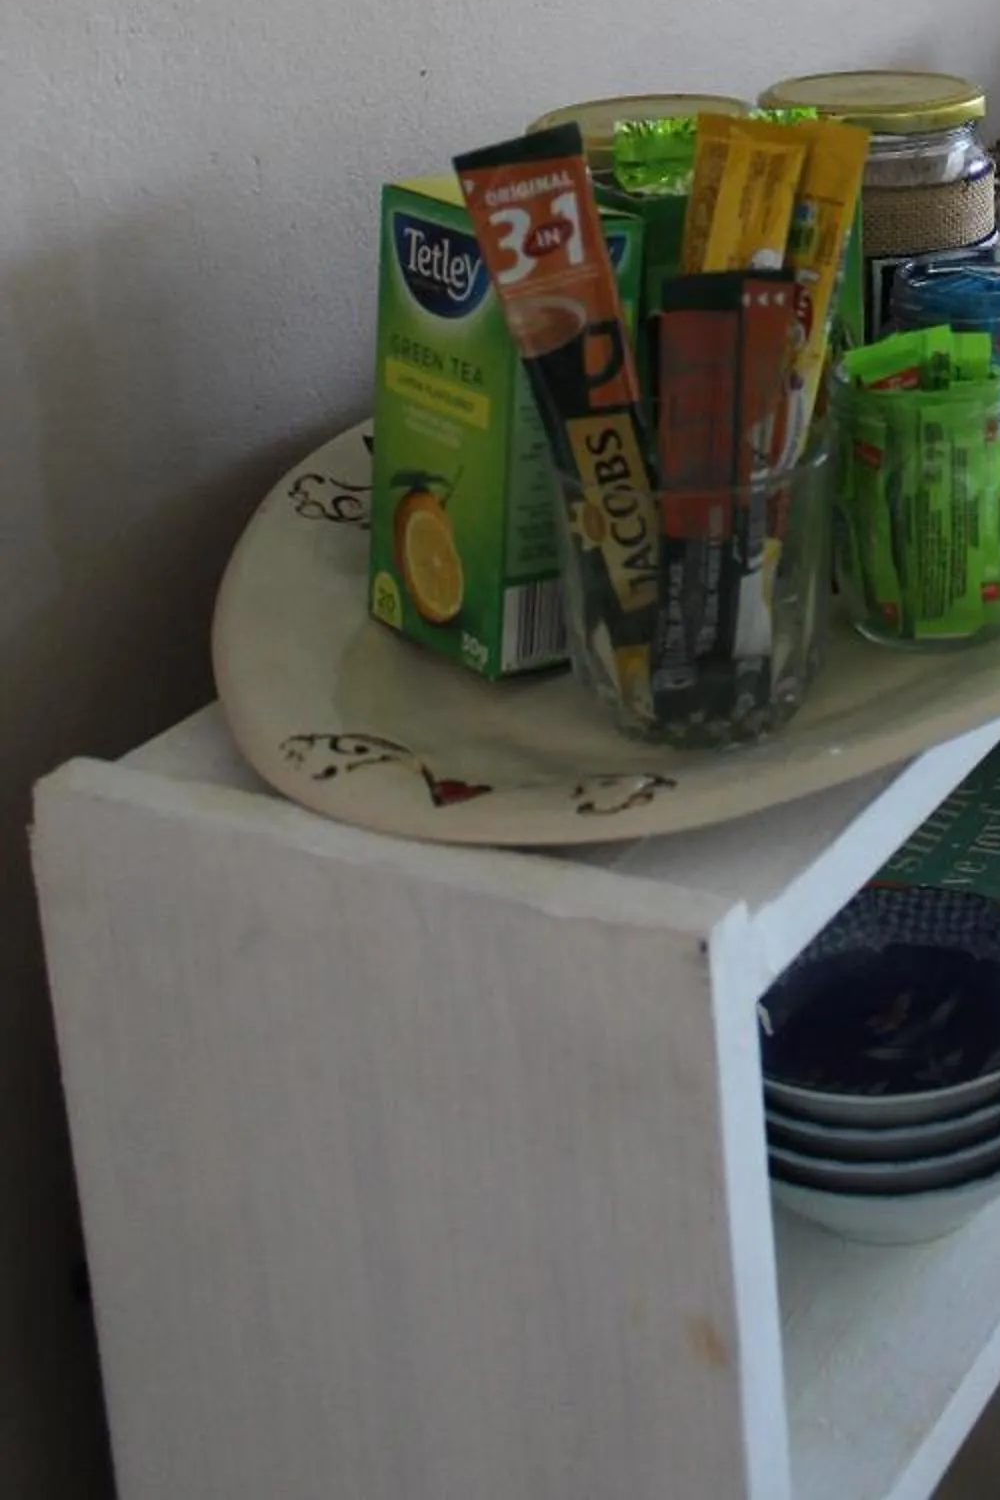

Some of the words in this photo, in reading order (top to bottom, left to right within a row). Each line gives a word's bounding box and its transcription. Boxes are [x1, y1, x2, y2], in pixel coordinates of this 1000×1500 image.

[485, 170, 575, 206] ORIGINAL
[403, 227, 481, 301] Tetley
[489, 208, 539, 285] 3
[535, 227, 562, 248] IN
[550, 191, 584, 265] 1
[390, 332, 443, 371] GREEN
[451, 355, 483, 387] TEA
[586, 428, 659, 593] JACOBS
[941, 860, 988, 885] ve
